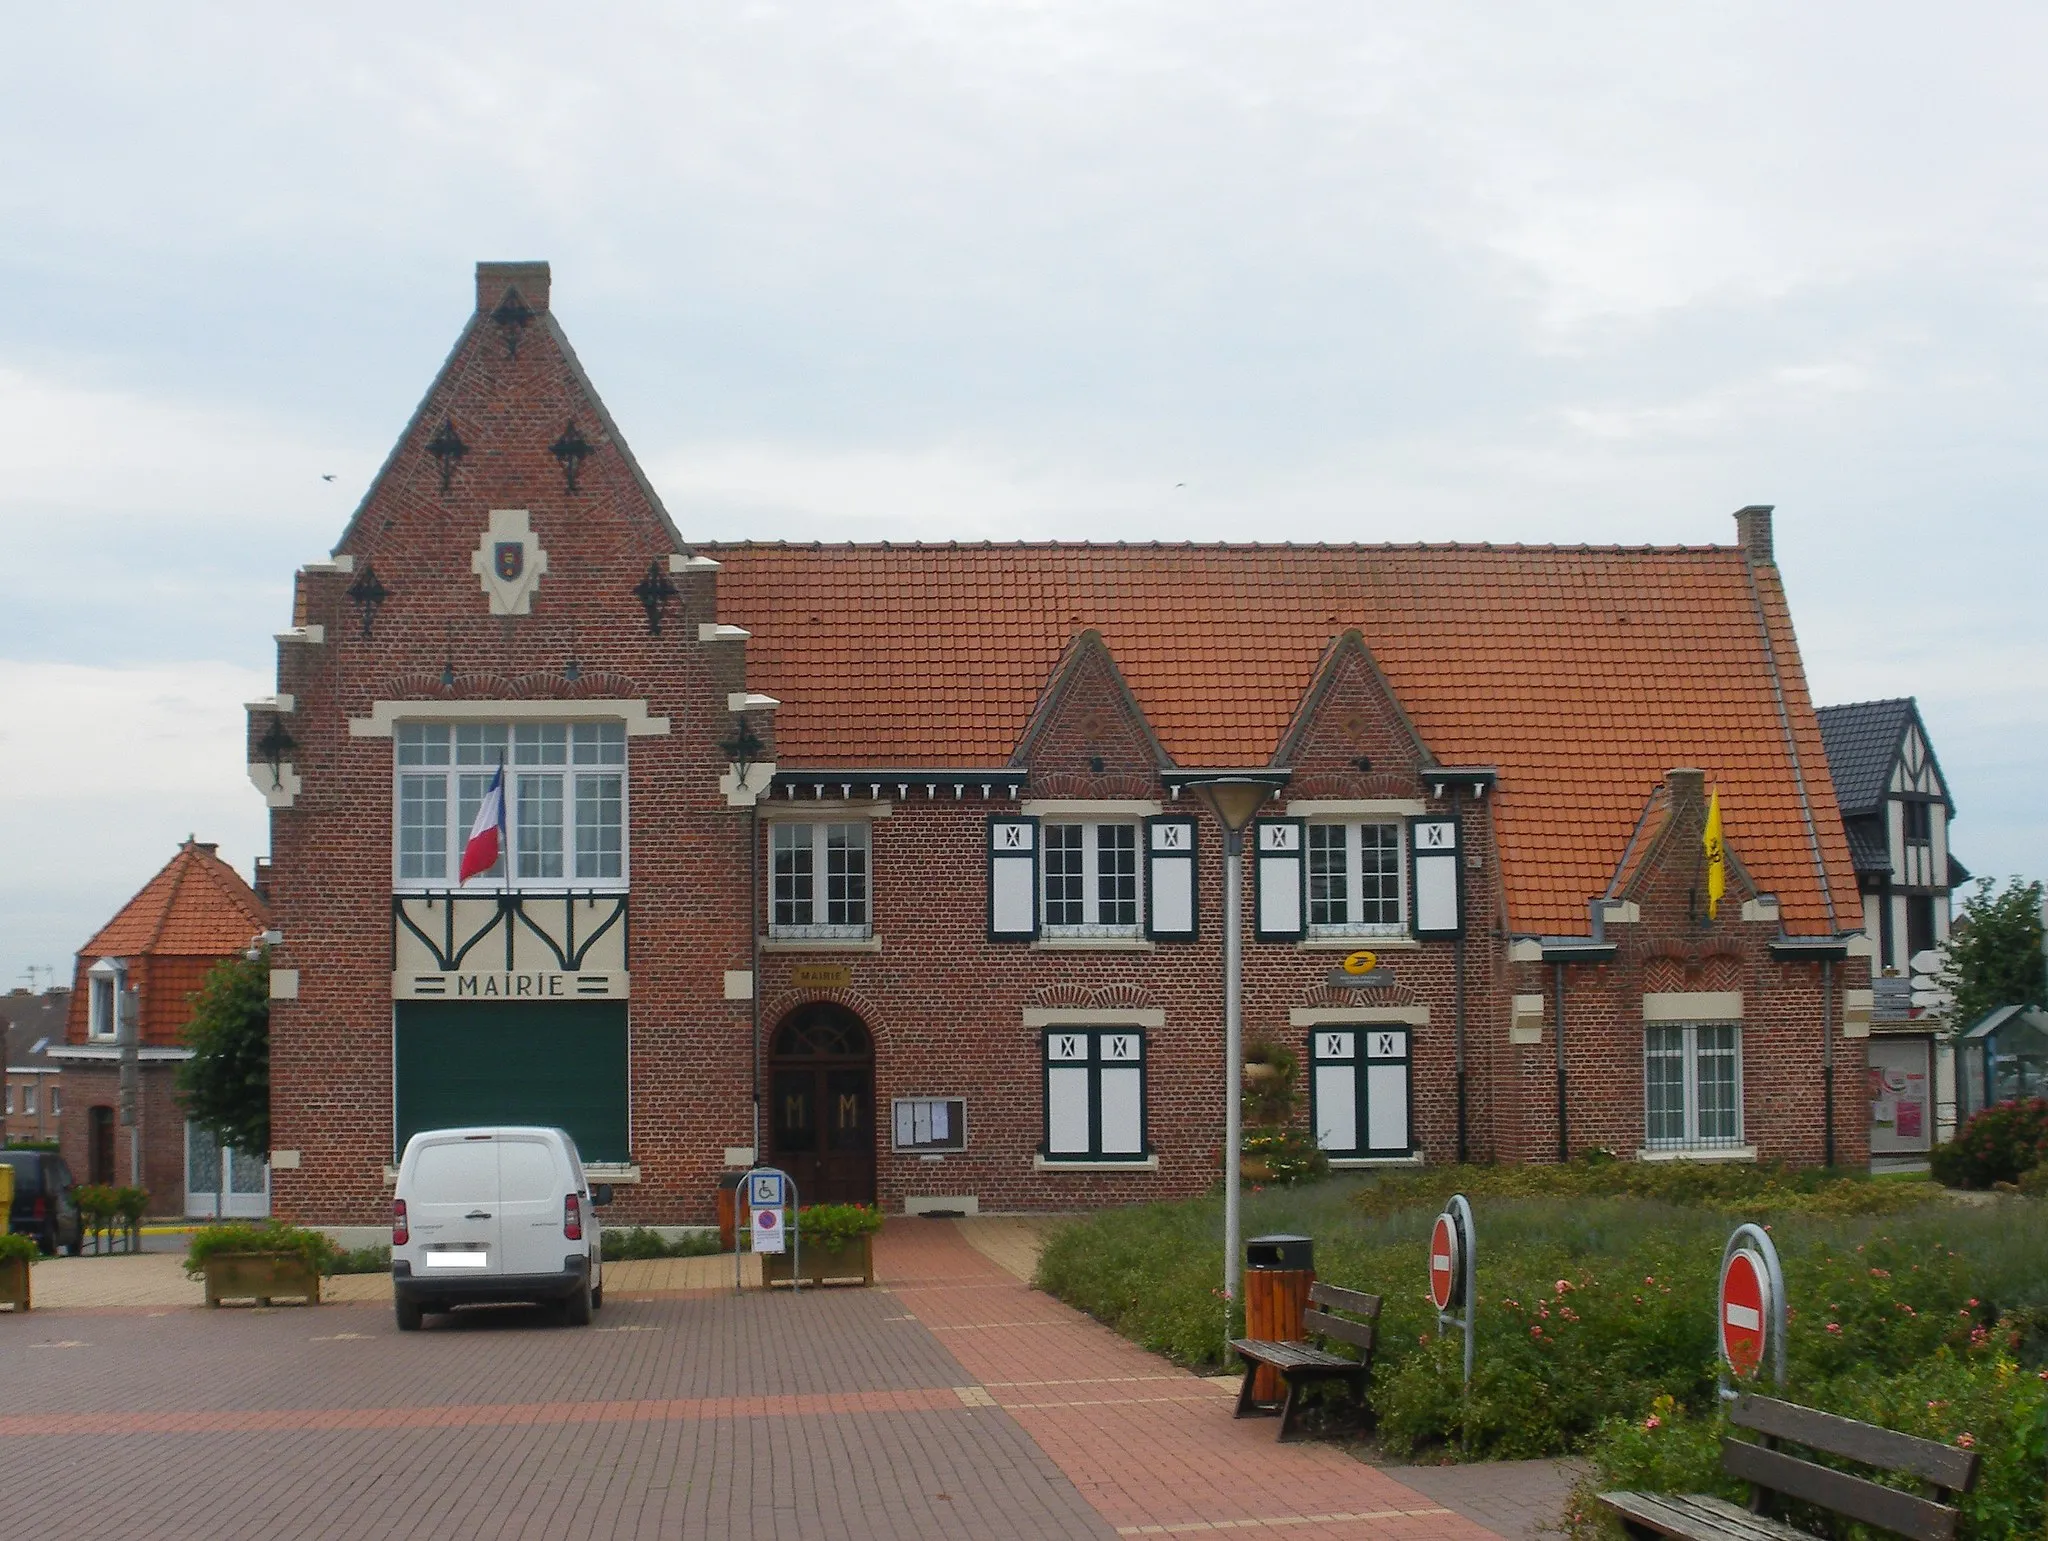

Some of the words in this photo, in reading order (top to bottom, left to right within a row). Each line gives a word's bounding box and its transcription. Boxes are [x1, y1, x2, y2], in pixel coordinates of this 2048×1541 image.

[800, 971, 841, 981] MAIRIE
[785, 1093, 804, 1129] M
[839, 1093, 857, 1129] M
